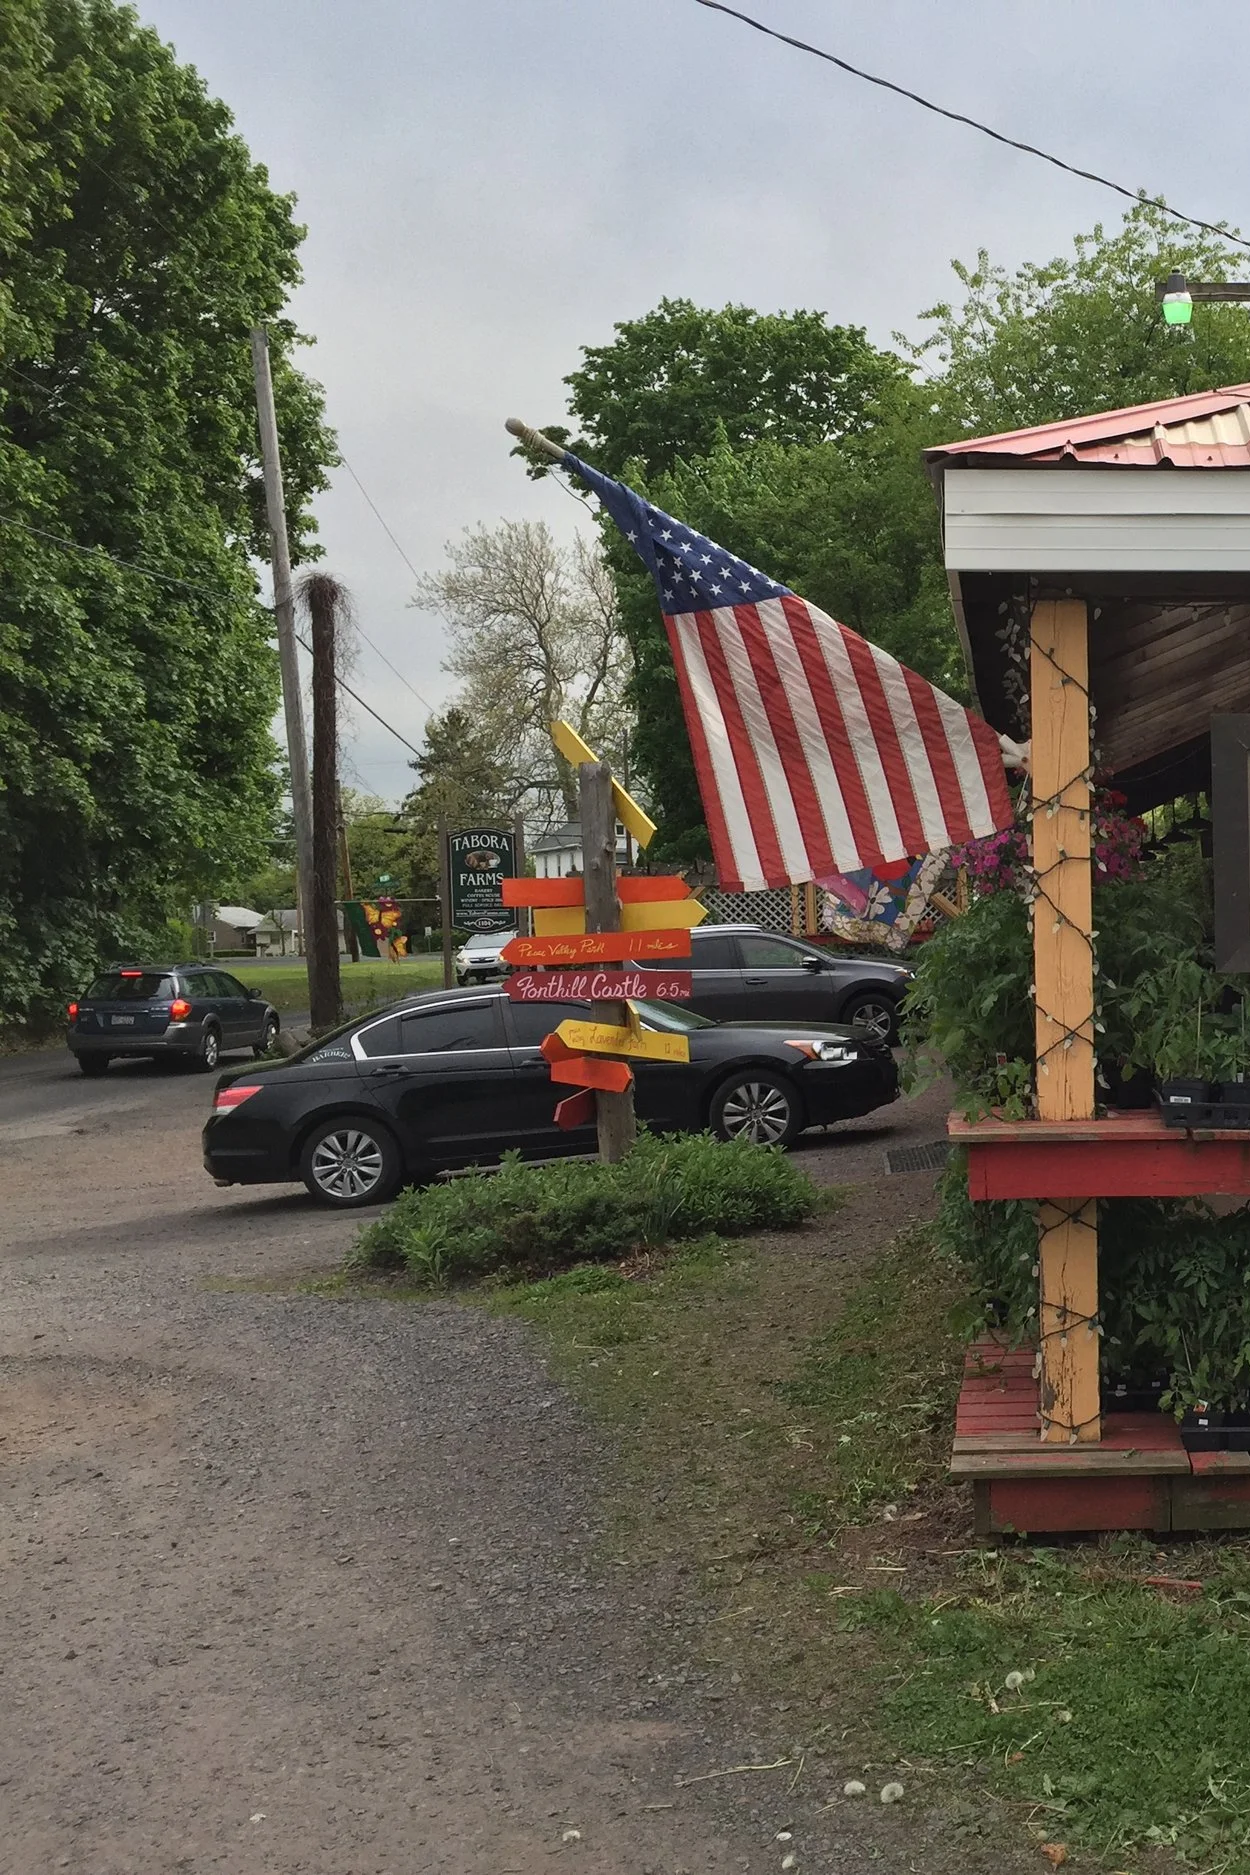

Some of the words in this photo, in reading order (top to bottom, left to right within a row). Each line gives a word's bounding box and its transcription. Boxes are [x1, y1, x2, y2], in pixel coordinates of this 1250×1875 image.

[452, 834, 509, 851] TABORA
[460, 872, 505, 886] FARMS
[548, 943, 577, 959] Valley
[517, 974, 588, 999] Fonthill
[591, 973, 647, 999] Castle
